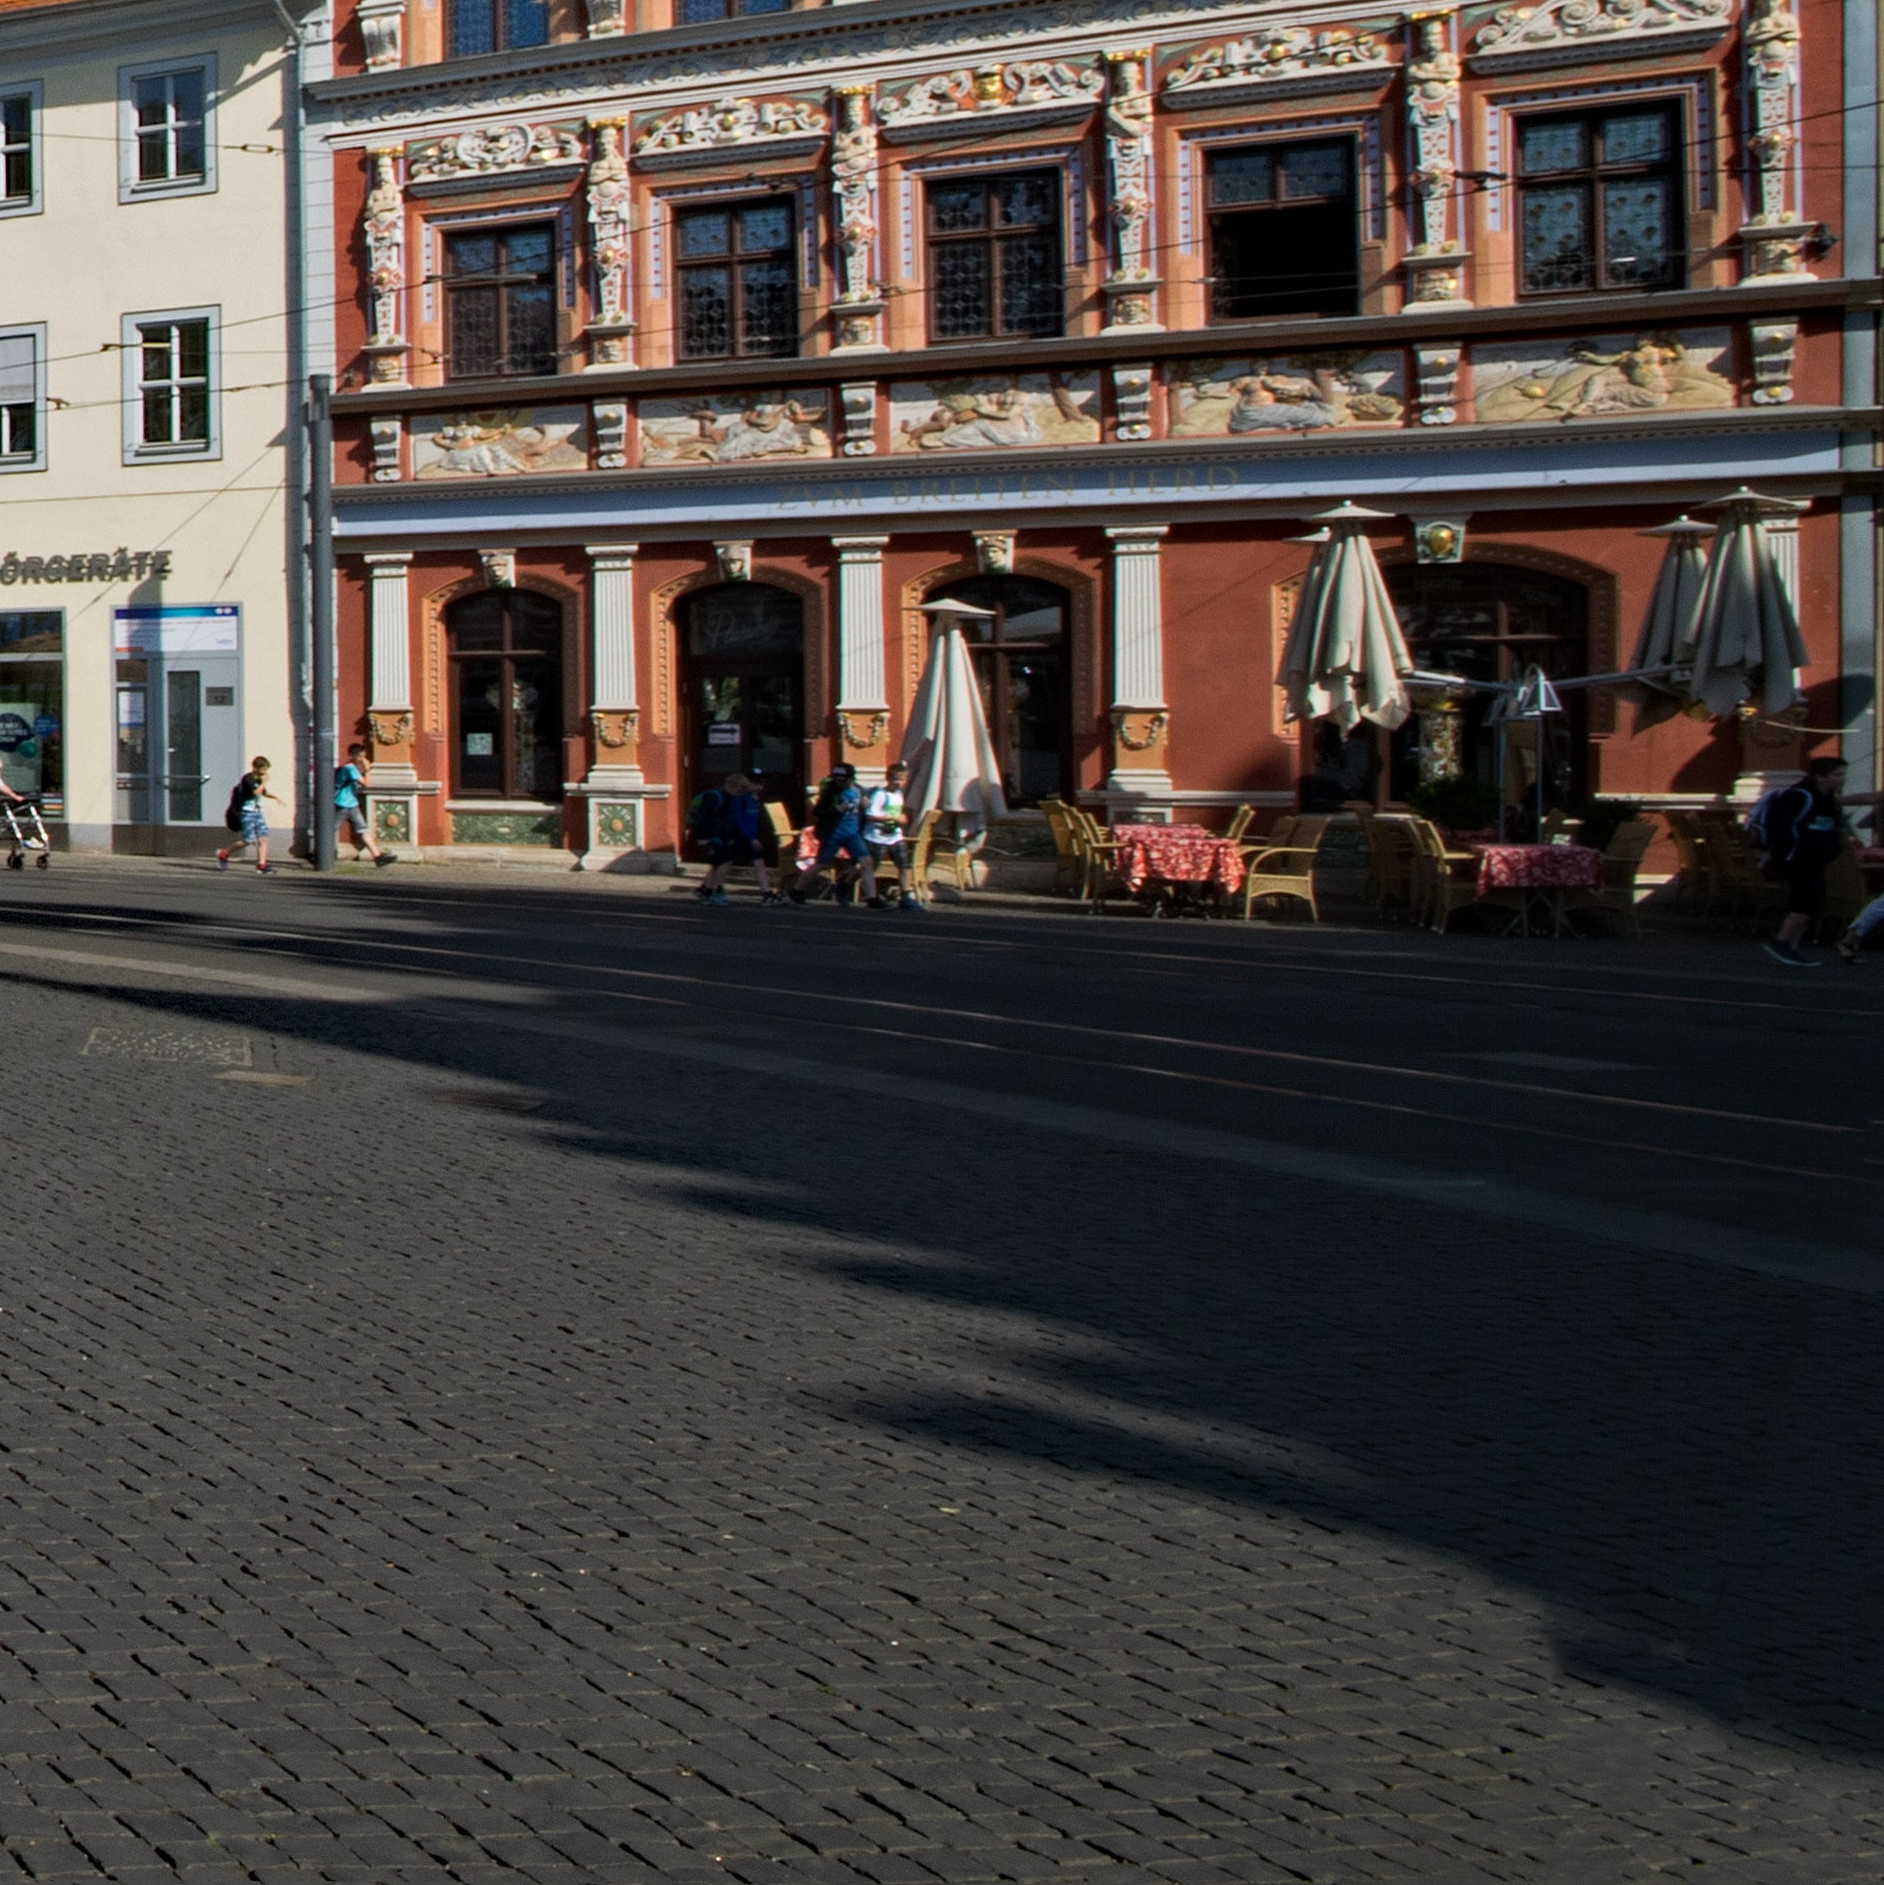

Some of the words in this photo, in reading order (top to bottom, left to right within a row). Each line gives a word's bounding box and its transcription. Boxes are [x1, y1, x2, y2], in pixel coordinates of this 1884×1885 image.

[777, 483, 864, 512] ZVM
[893, 472, 1077, 507] BREITEN
[1107, 465, 1240, 496] HERD
